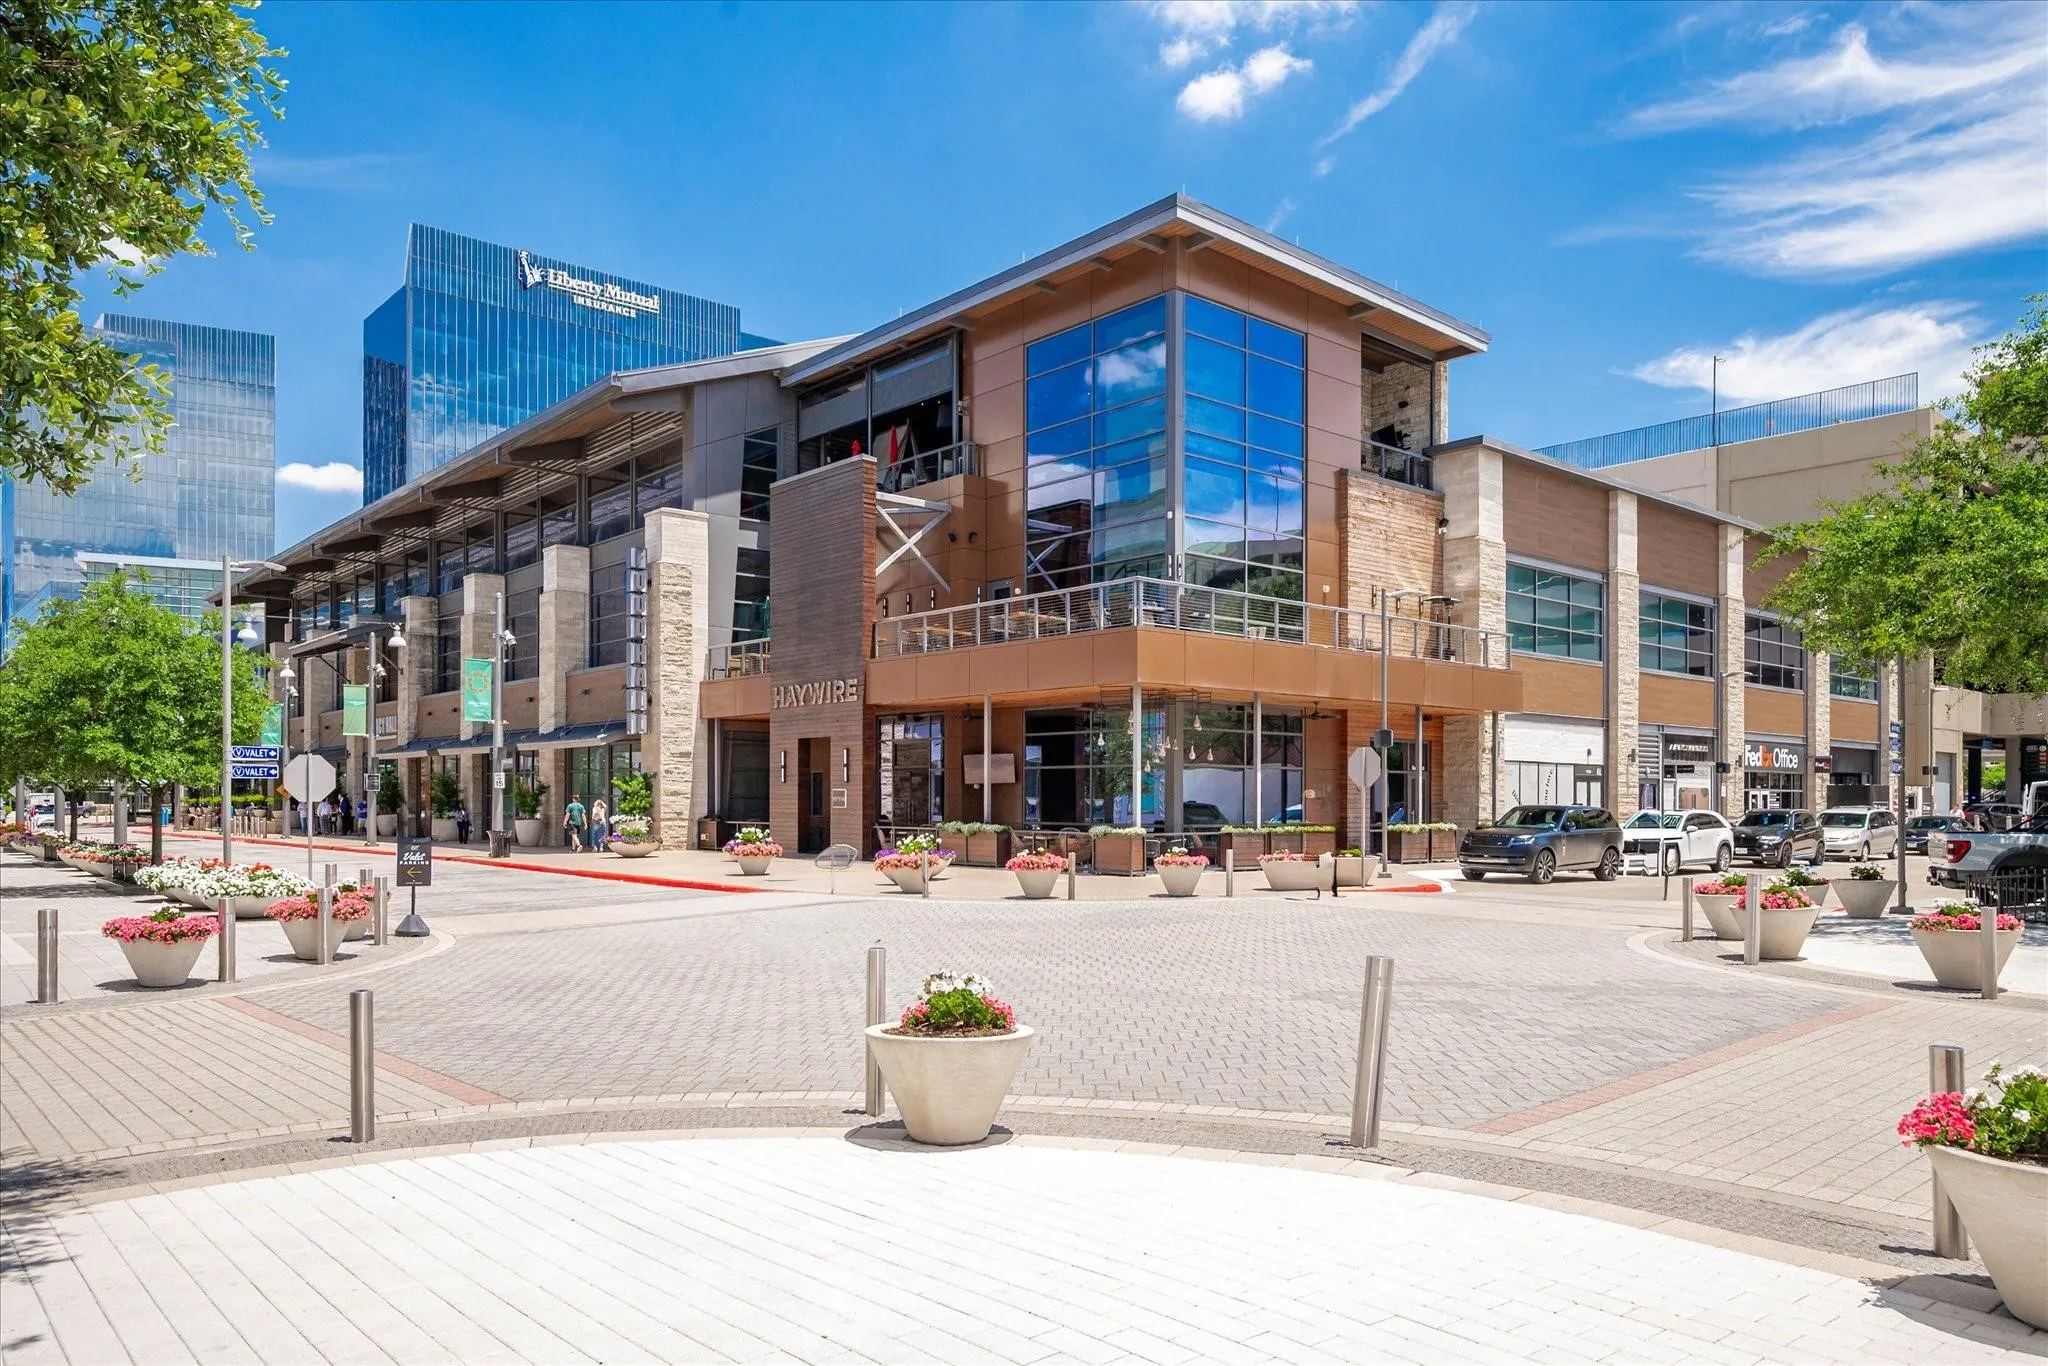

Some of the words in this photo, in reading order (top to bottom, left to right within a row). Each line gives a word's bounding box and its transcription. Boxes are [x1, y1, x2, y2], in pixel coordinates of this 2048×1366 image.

[548, 268, 604, 298] Liberty
[604, 283, 660, 309] Mutual
[574, 295, 637, 318] INSURANCE
[773, 678, 858, 708] HAYWIRE
[245, 749, 269, 758] VALET
[1744, 744, 1774, 768] FedEx
[1773, 747, 1799, 769] Office
[245, 767, 269, 776] VALET
[403, 852, 426, 860] Valet
